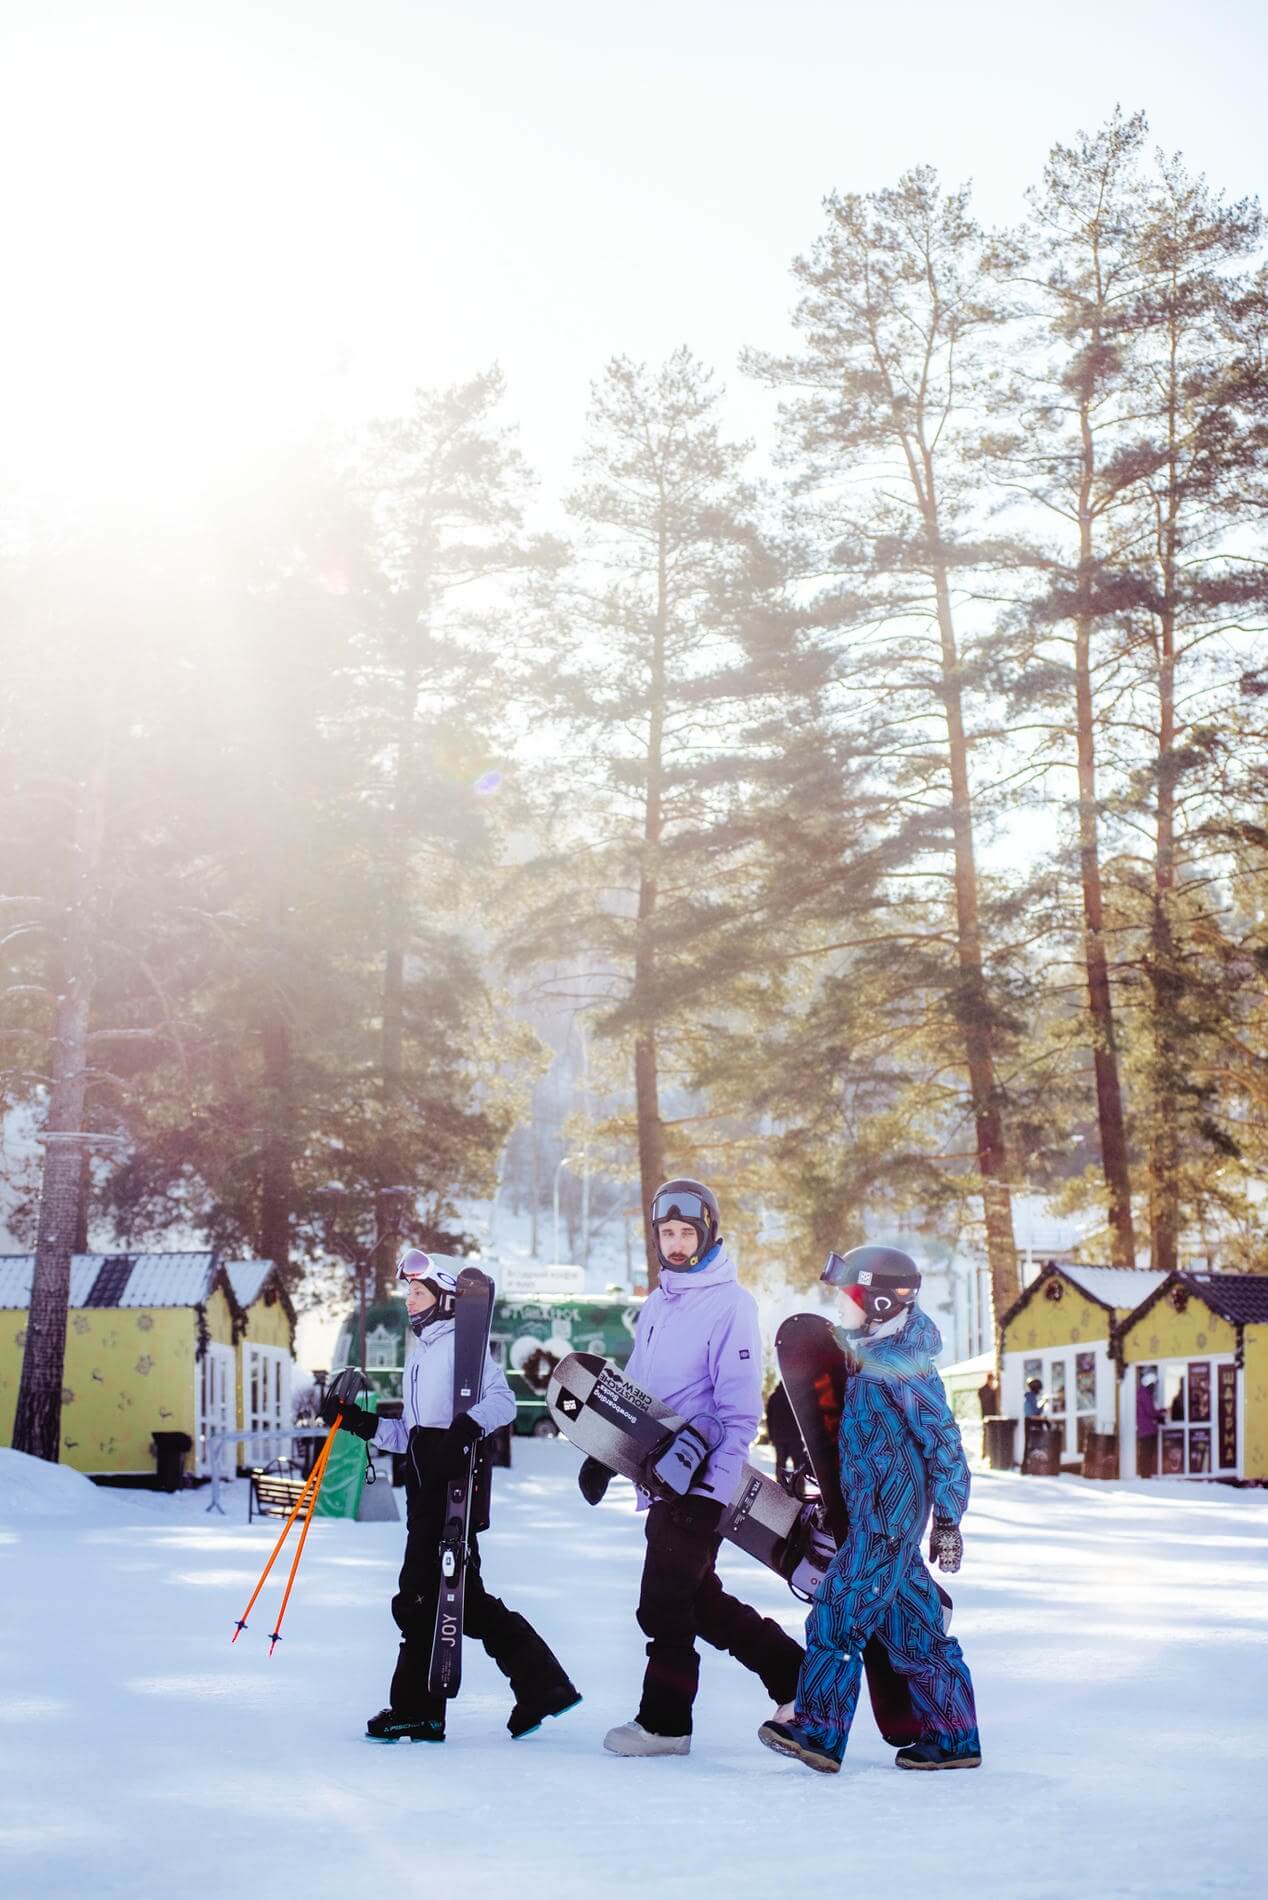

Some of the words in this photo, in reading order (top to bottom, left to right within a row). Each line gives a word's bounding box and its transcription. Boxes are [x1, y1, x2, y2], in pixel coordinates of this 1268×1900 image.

[593, 1388, 637, 1424] Snowboarding
[599, 1373, 650, 1412] MOUSTACHE
[622, 1382, 653, 1408] CREW
[1223, 1371, 1235, 1460] ШАУРМА
[441, 1613, 458, 1648] JOY
